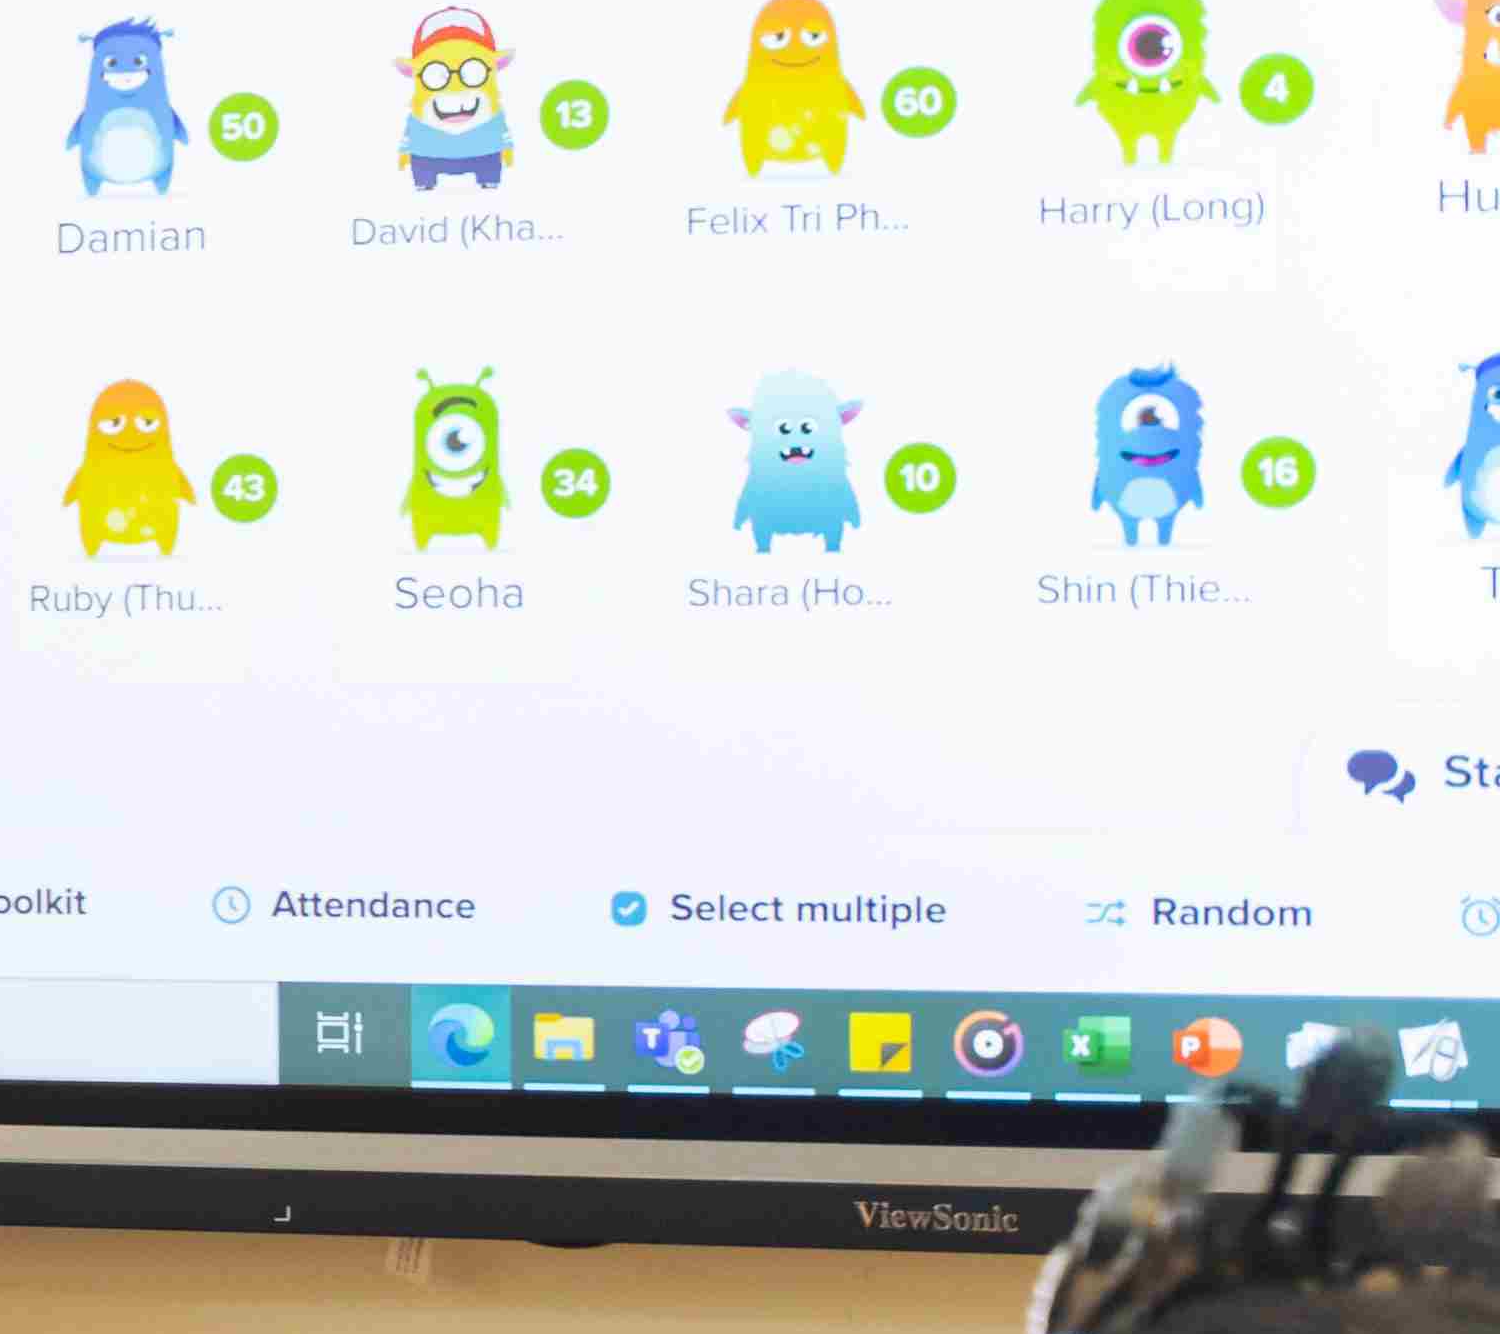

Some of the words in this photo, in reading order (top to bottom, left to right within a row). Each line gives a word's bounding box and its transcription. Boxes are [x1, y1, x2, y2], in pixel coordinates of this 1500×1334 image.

[893, 86, 944, 118] 60
[1264, 73, 1290, 104] 4
[220, 112, 266, 142] 50
[555, 100, 593, 130] 13
[686, 205, 770, 237] Felix
[780, 203, 823, 234] Tri
[1038, 193, 1141, 231] Harry
[1150, 190, 1267, 229] (Long)
[56, 220, 207, 255] Damian
[351, 216, 449, 248] David
[460, 213, 564, 250] (Kha...
[222, 473, 267, 503] 43
[552, 468, 599, 498] 34
[900, 461, 942, 494] 10
[1257, 455, 1300, 488] 16
[29, 583, 113, 620] Ruby
[122, 582, 224, 618] (Thu...
[395, 576, 526, 611] Seoha
[686, 577, 790, 610] Shara
[800, 577, 893, 612] (Ho...
[1036, 573, 1118, 607] Shin
[1128, 573, 1253, 610] (Thie...
[271, 889, 477, 920] Attendance
[669, 892, 784, 925] Select
[795, 894, 948, 931] multiple
[1150, 896, 1314, 928] Random
[854, 1198, 1020, 1234] ViewSonic
